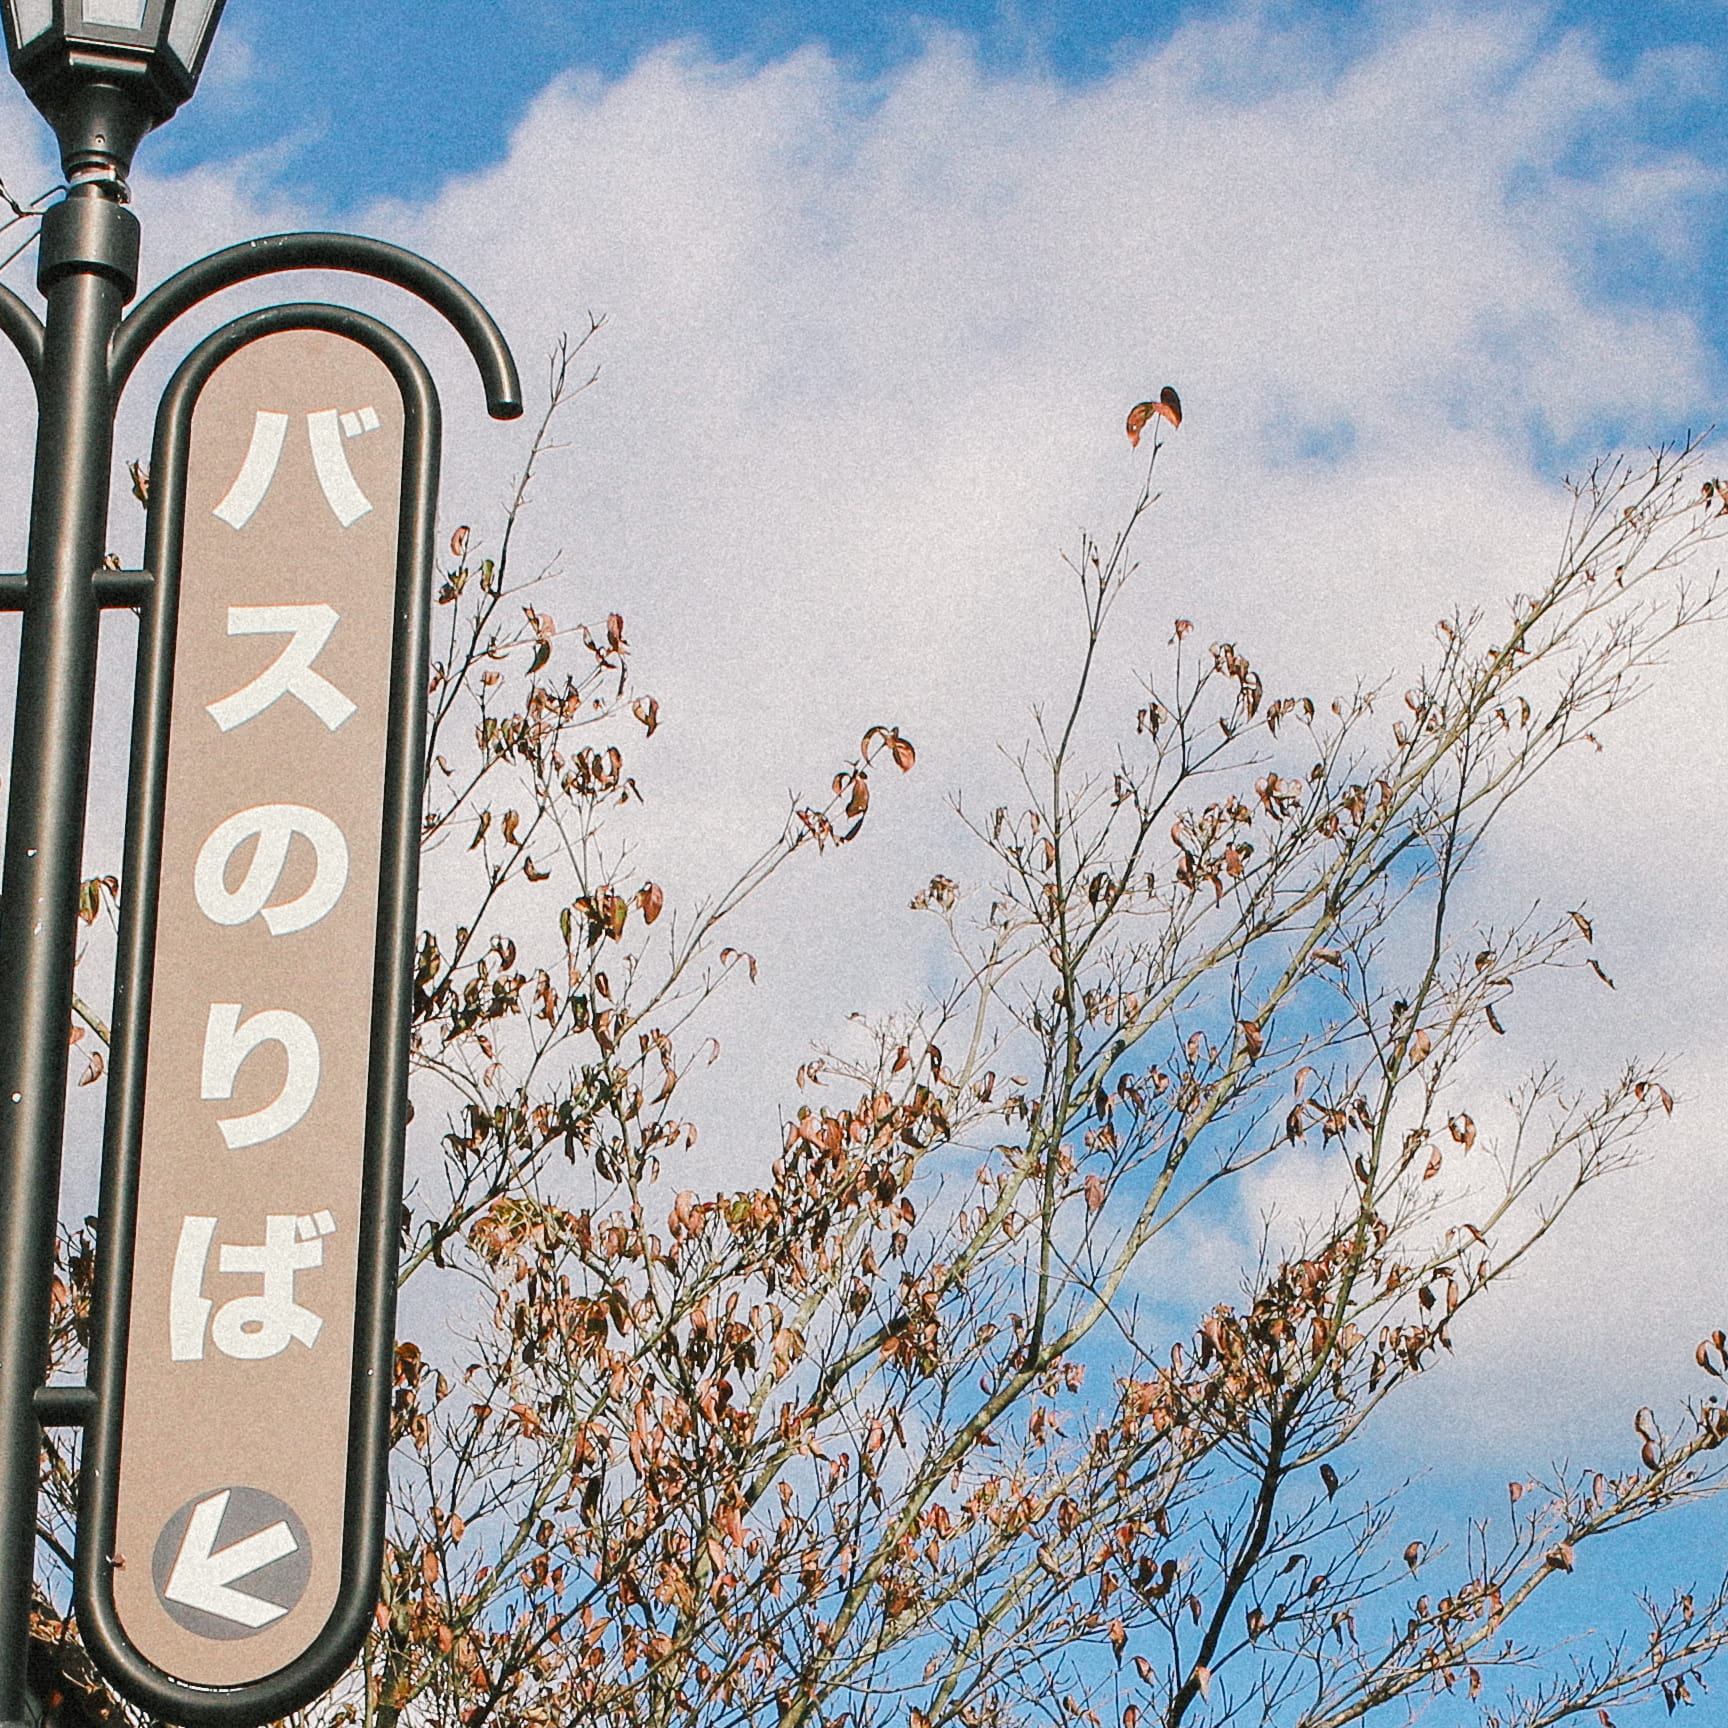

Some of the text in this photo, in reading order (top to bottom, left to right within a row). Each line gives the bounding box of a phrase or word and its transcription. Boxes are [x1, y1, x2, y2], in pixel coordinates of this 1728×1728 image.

[171, 406, 379, 1361] バスのりば
